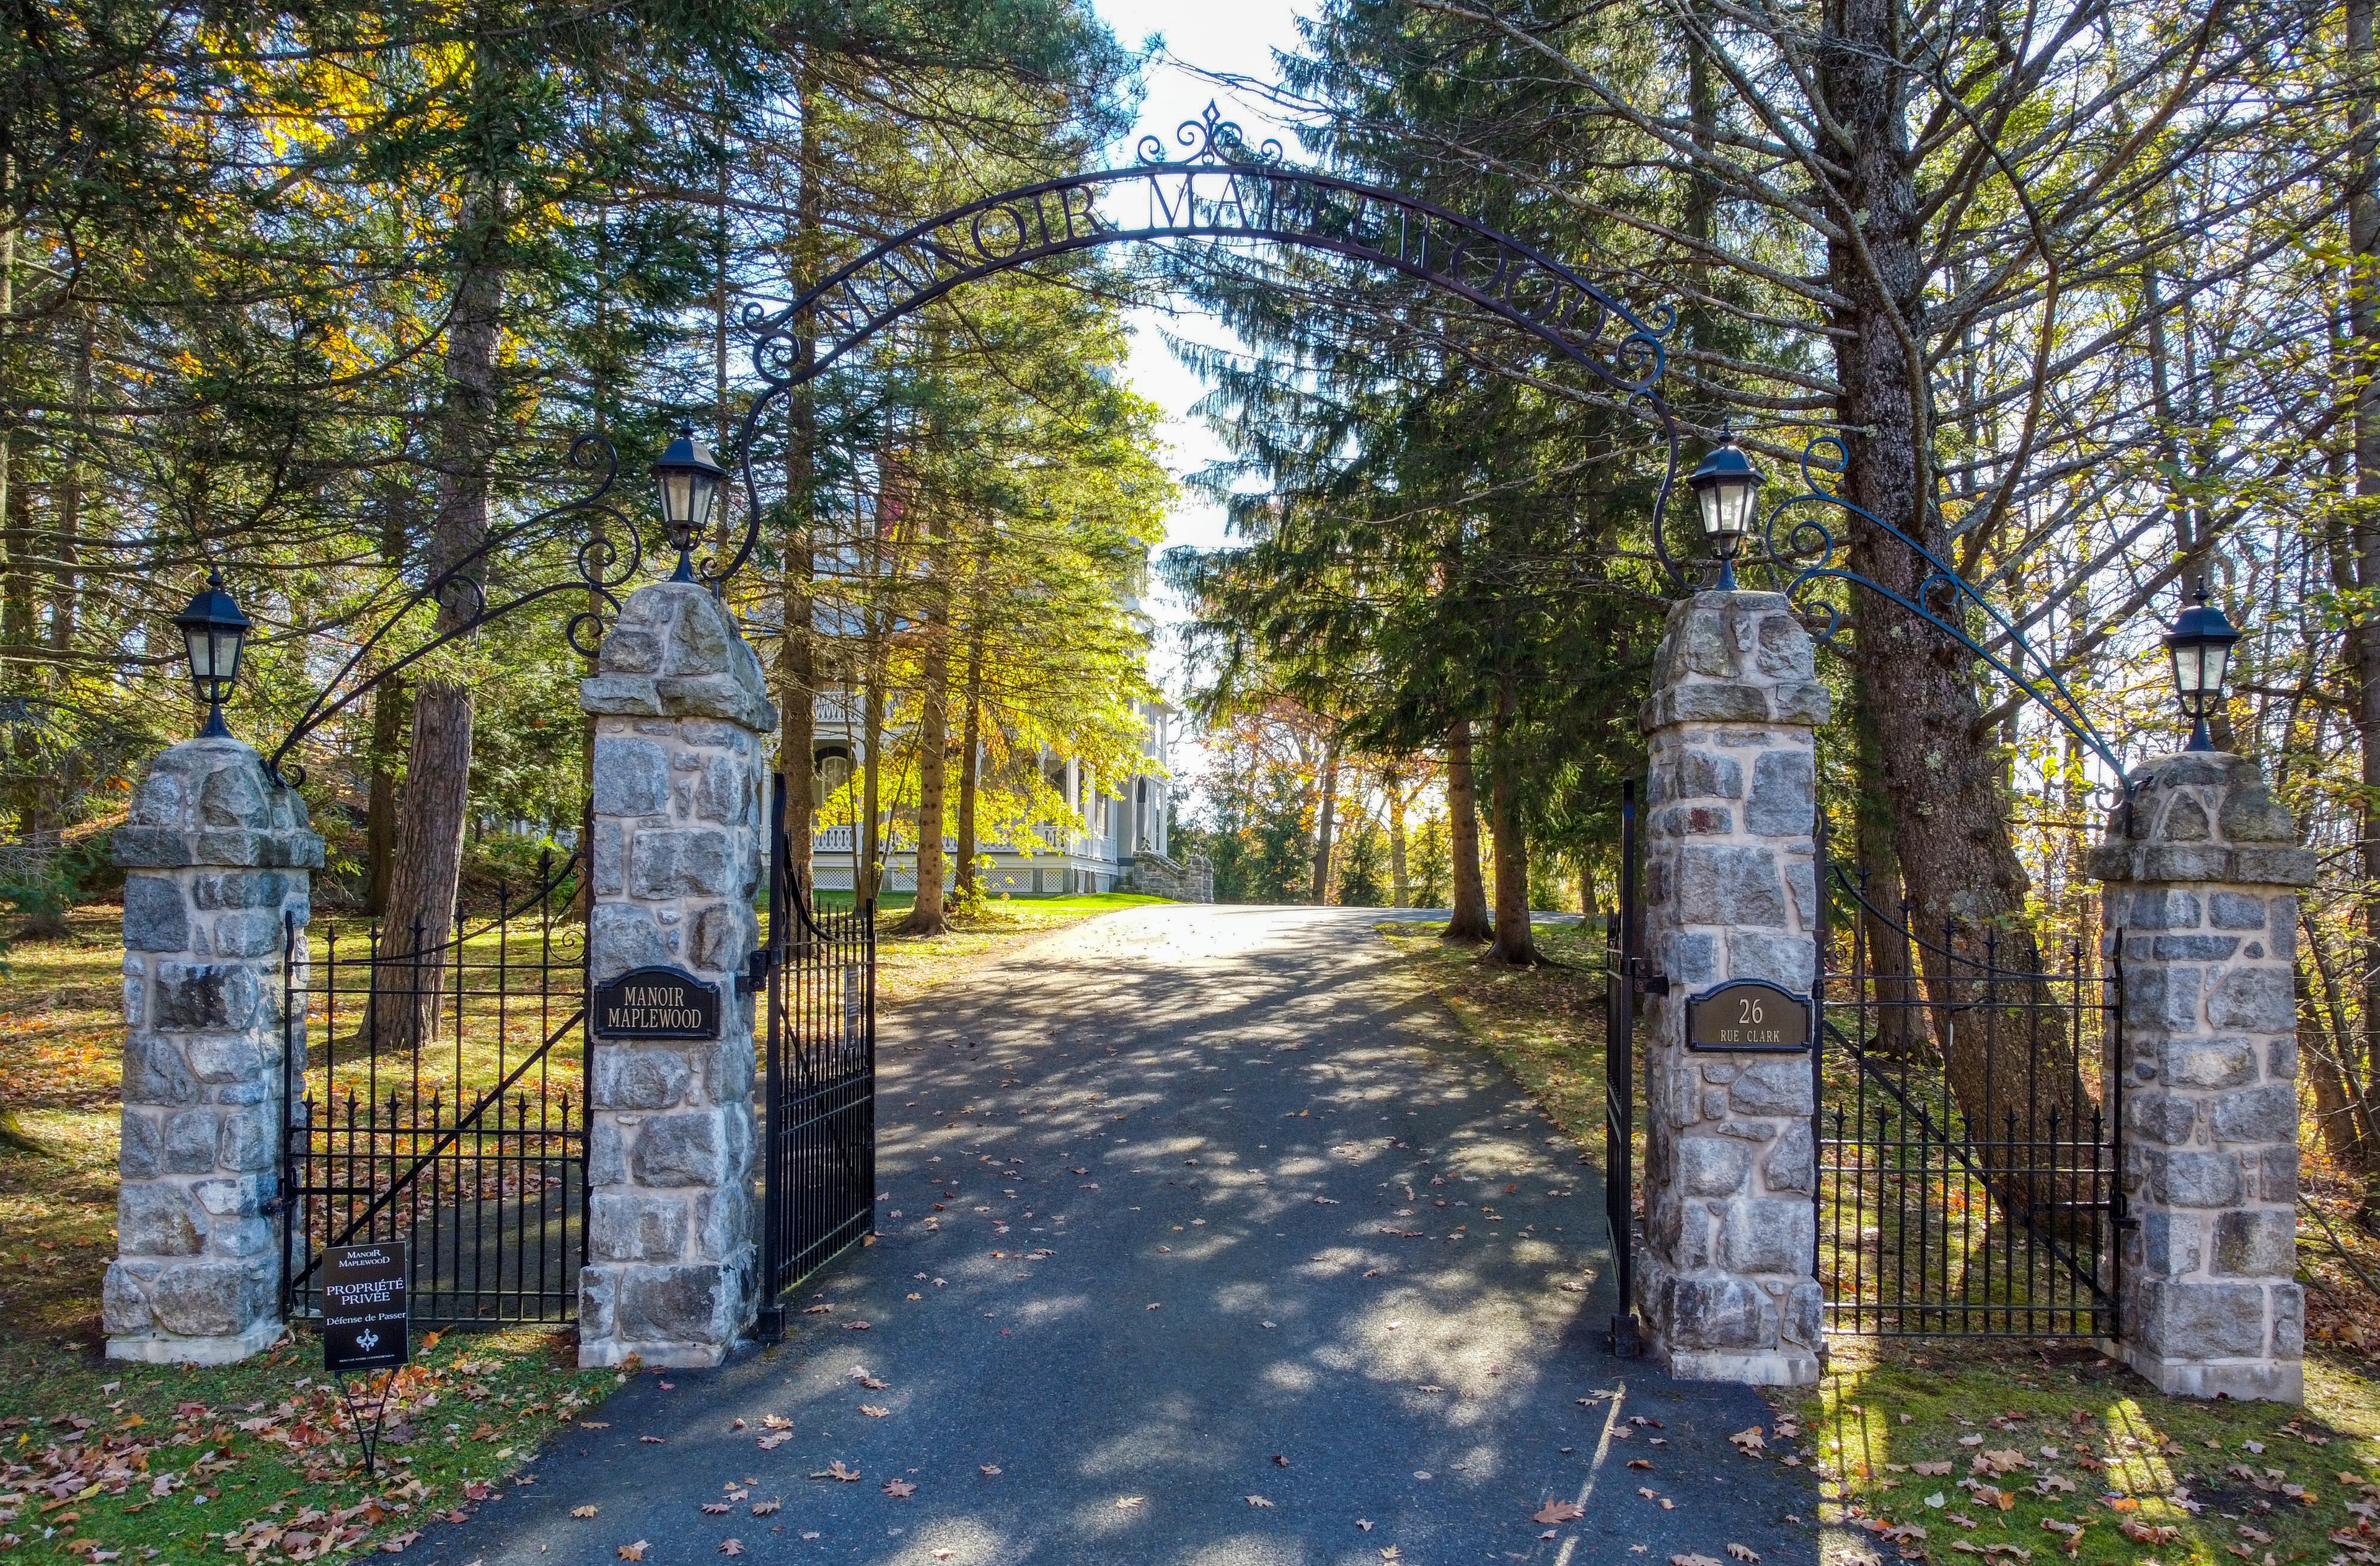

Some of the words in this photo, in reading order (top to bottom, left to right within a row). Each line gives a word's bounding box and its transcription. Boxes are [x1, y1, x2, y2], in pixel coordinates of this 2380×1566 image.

[811, 184, 1112, 345] MANOIR
[1142, 172, 1608, 348] MAPLEWOOD
[624, 986, 684, 1007] MANOIR
[607, 1008, 702, 1029] MAPLEWOOD
[1738, 999, 1763, 1024] 26
[1720, 1030, 1739, 1042] RUE
[1747, 1030, 1780, 1043] CLARK
[327, 1277, 403, 1296] PROPRIÉTÉ
[342, 1290, 390, 1306] PRIVÉE
[327, 1316, 363, 1325] Défense
[365, 1314, 376, 1322] de
[379, 1312, 407, 1320] Passer
